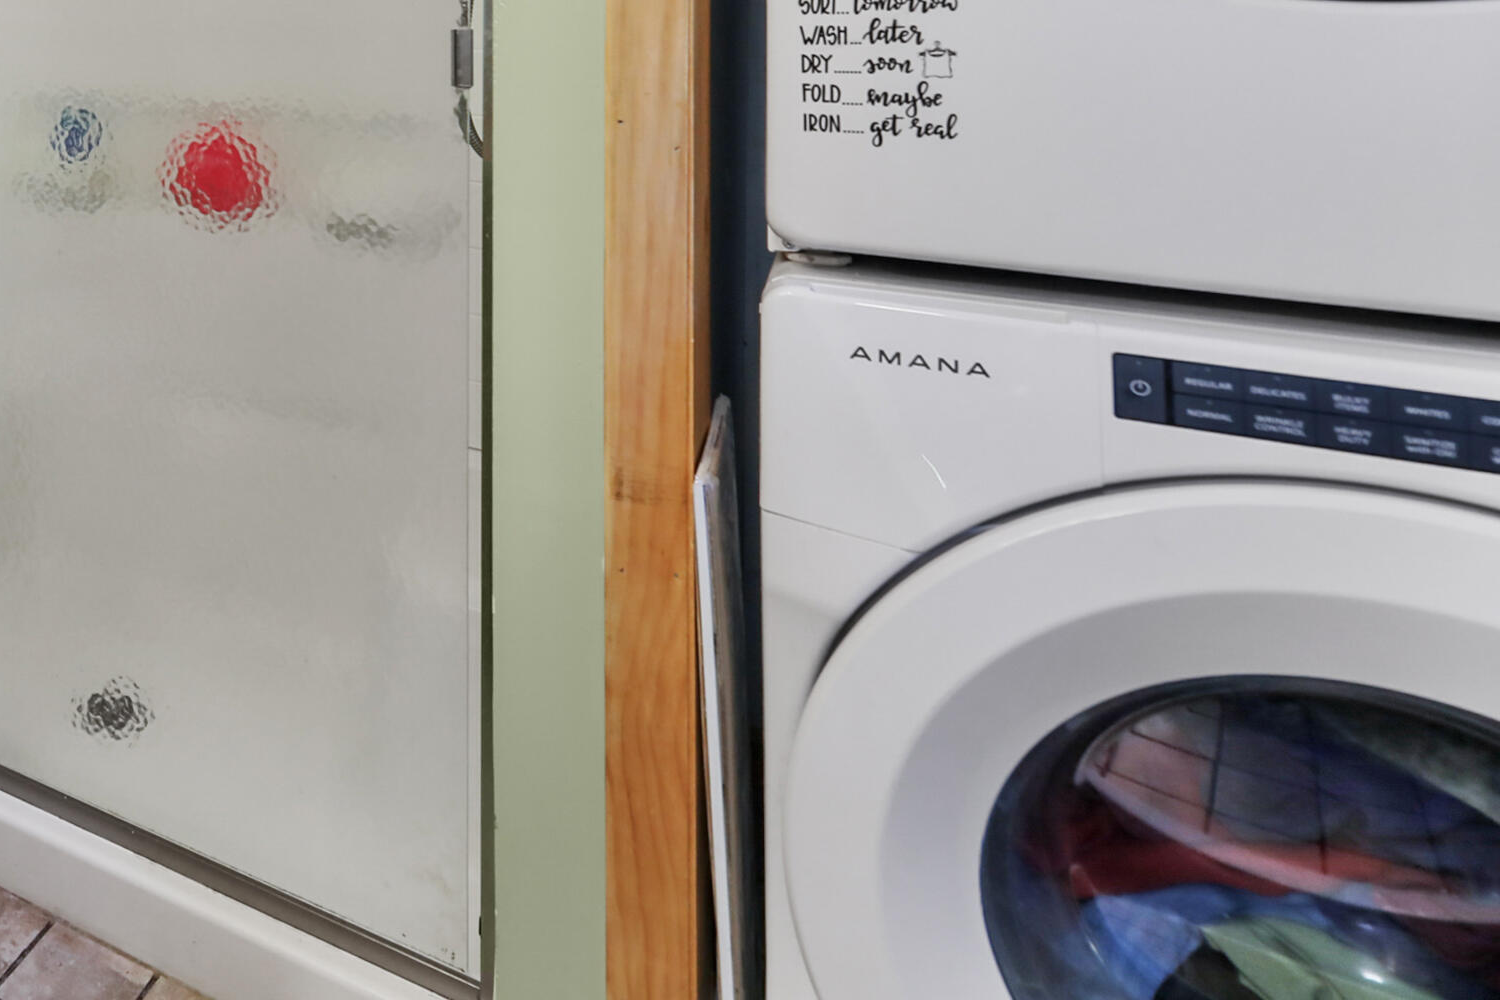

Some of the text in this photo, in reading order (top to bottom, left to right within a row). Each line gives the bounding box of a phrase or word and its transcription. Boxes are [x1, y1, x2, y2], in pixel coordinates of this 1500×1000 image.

[862, 17, 924, 46] later
[862, 57, 913, 74] soon
[866, 81, 943, 118] maybe
[870, 114, 904, 147] get
[910, 113, 958, 140] real
[850, 346, 991, 379] AMANA
